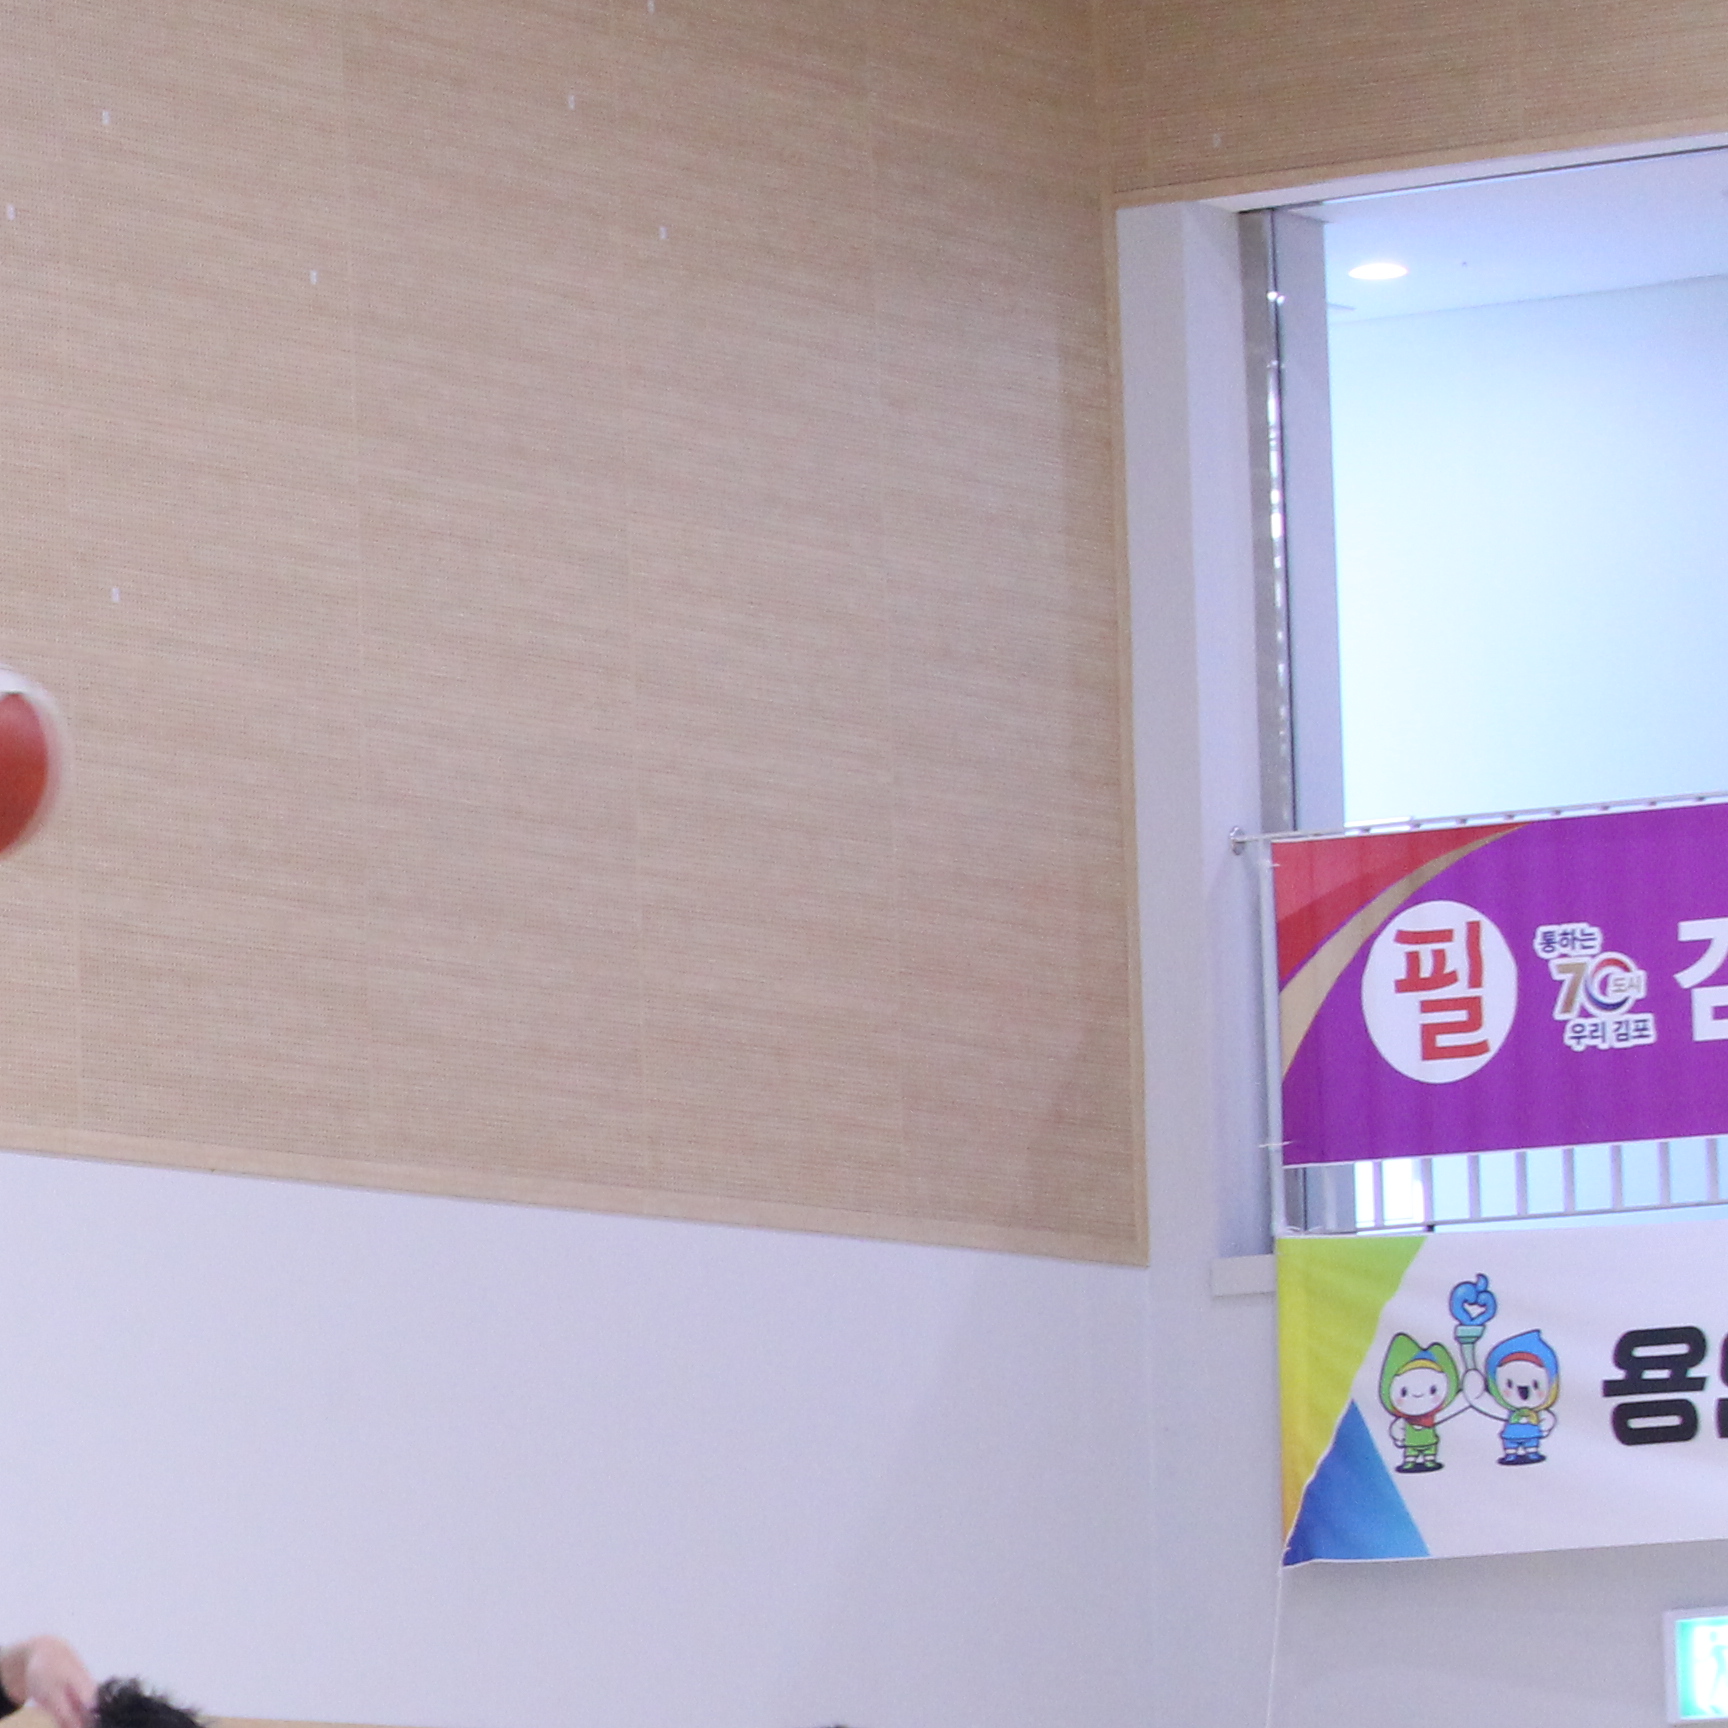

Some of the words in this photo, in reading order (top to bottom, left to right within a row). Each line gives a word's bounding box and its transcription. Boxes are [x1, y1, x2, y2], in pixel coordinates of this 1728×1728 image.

[1538, 928, 1597, 954] 통하는
[1393, 920, 1491, 1062] 필
[1568, 1021, 1607, 1046] 우리
[1613, 1018, 1652, 1043] 김포
[1601, 1325, 1728, 1446] 용
